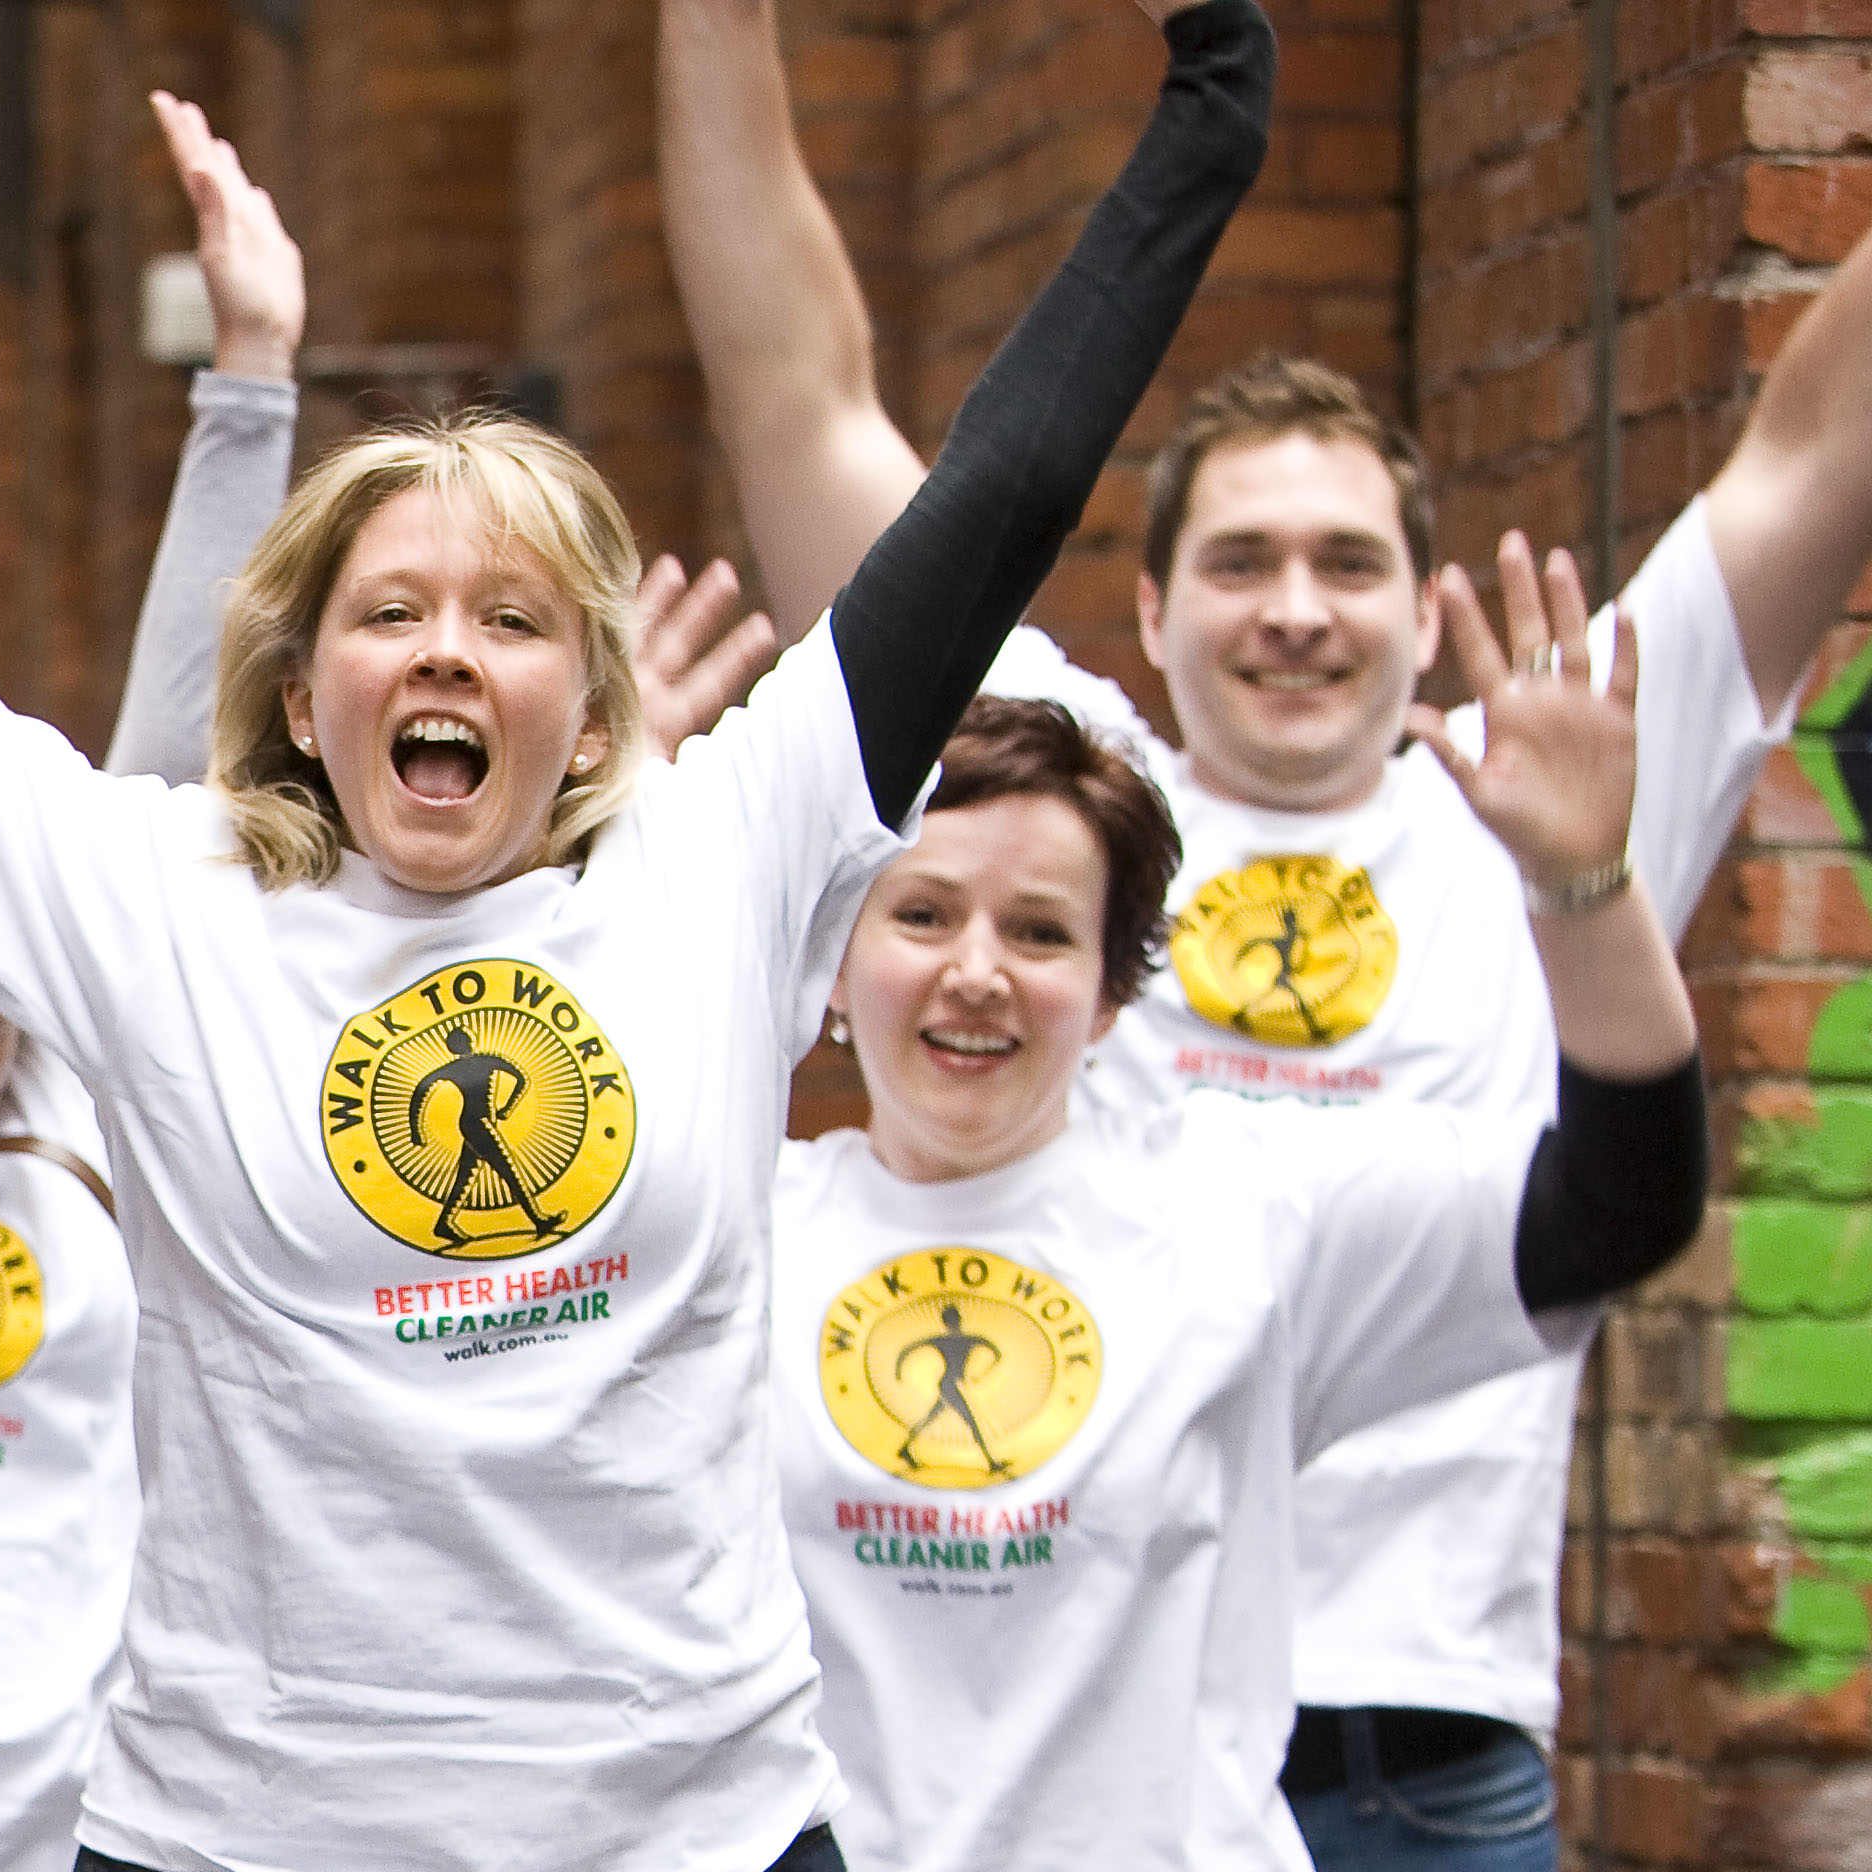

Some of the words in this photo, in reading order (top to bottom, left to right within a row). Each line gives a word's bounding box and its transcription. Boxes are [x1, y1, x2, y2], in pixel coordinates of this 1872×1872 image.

[328, 1007, 411, 1135] WALK
[420, 969, 486, 1016] TO
[514, 969, 625, 1100] WORK
[374, 1277, 493, 1317] BETTER
[505, 1253, 629, 1303] HEALTH
[931, 1255, 989, 1287] TO
[396, 1304, 550, 1344] CLEANER
[555, 1290, 610, 1323] AIR
[949, 1497, 1070, 1537] HEALTH
[855, 1534, 991, 1571] CLEANER
[1002, 1534, 1053, 1567] AIR
